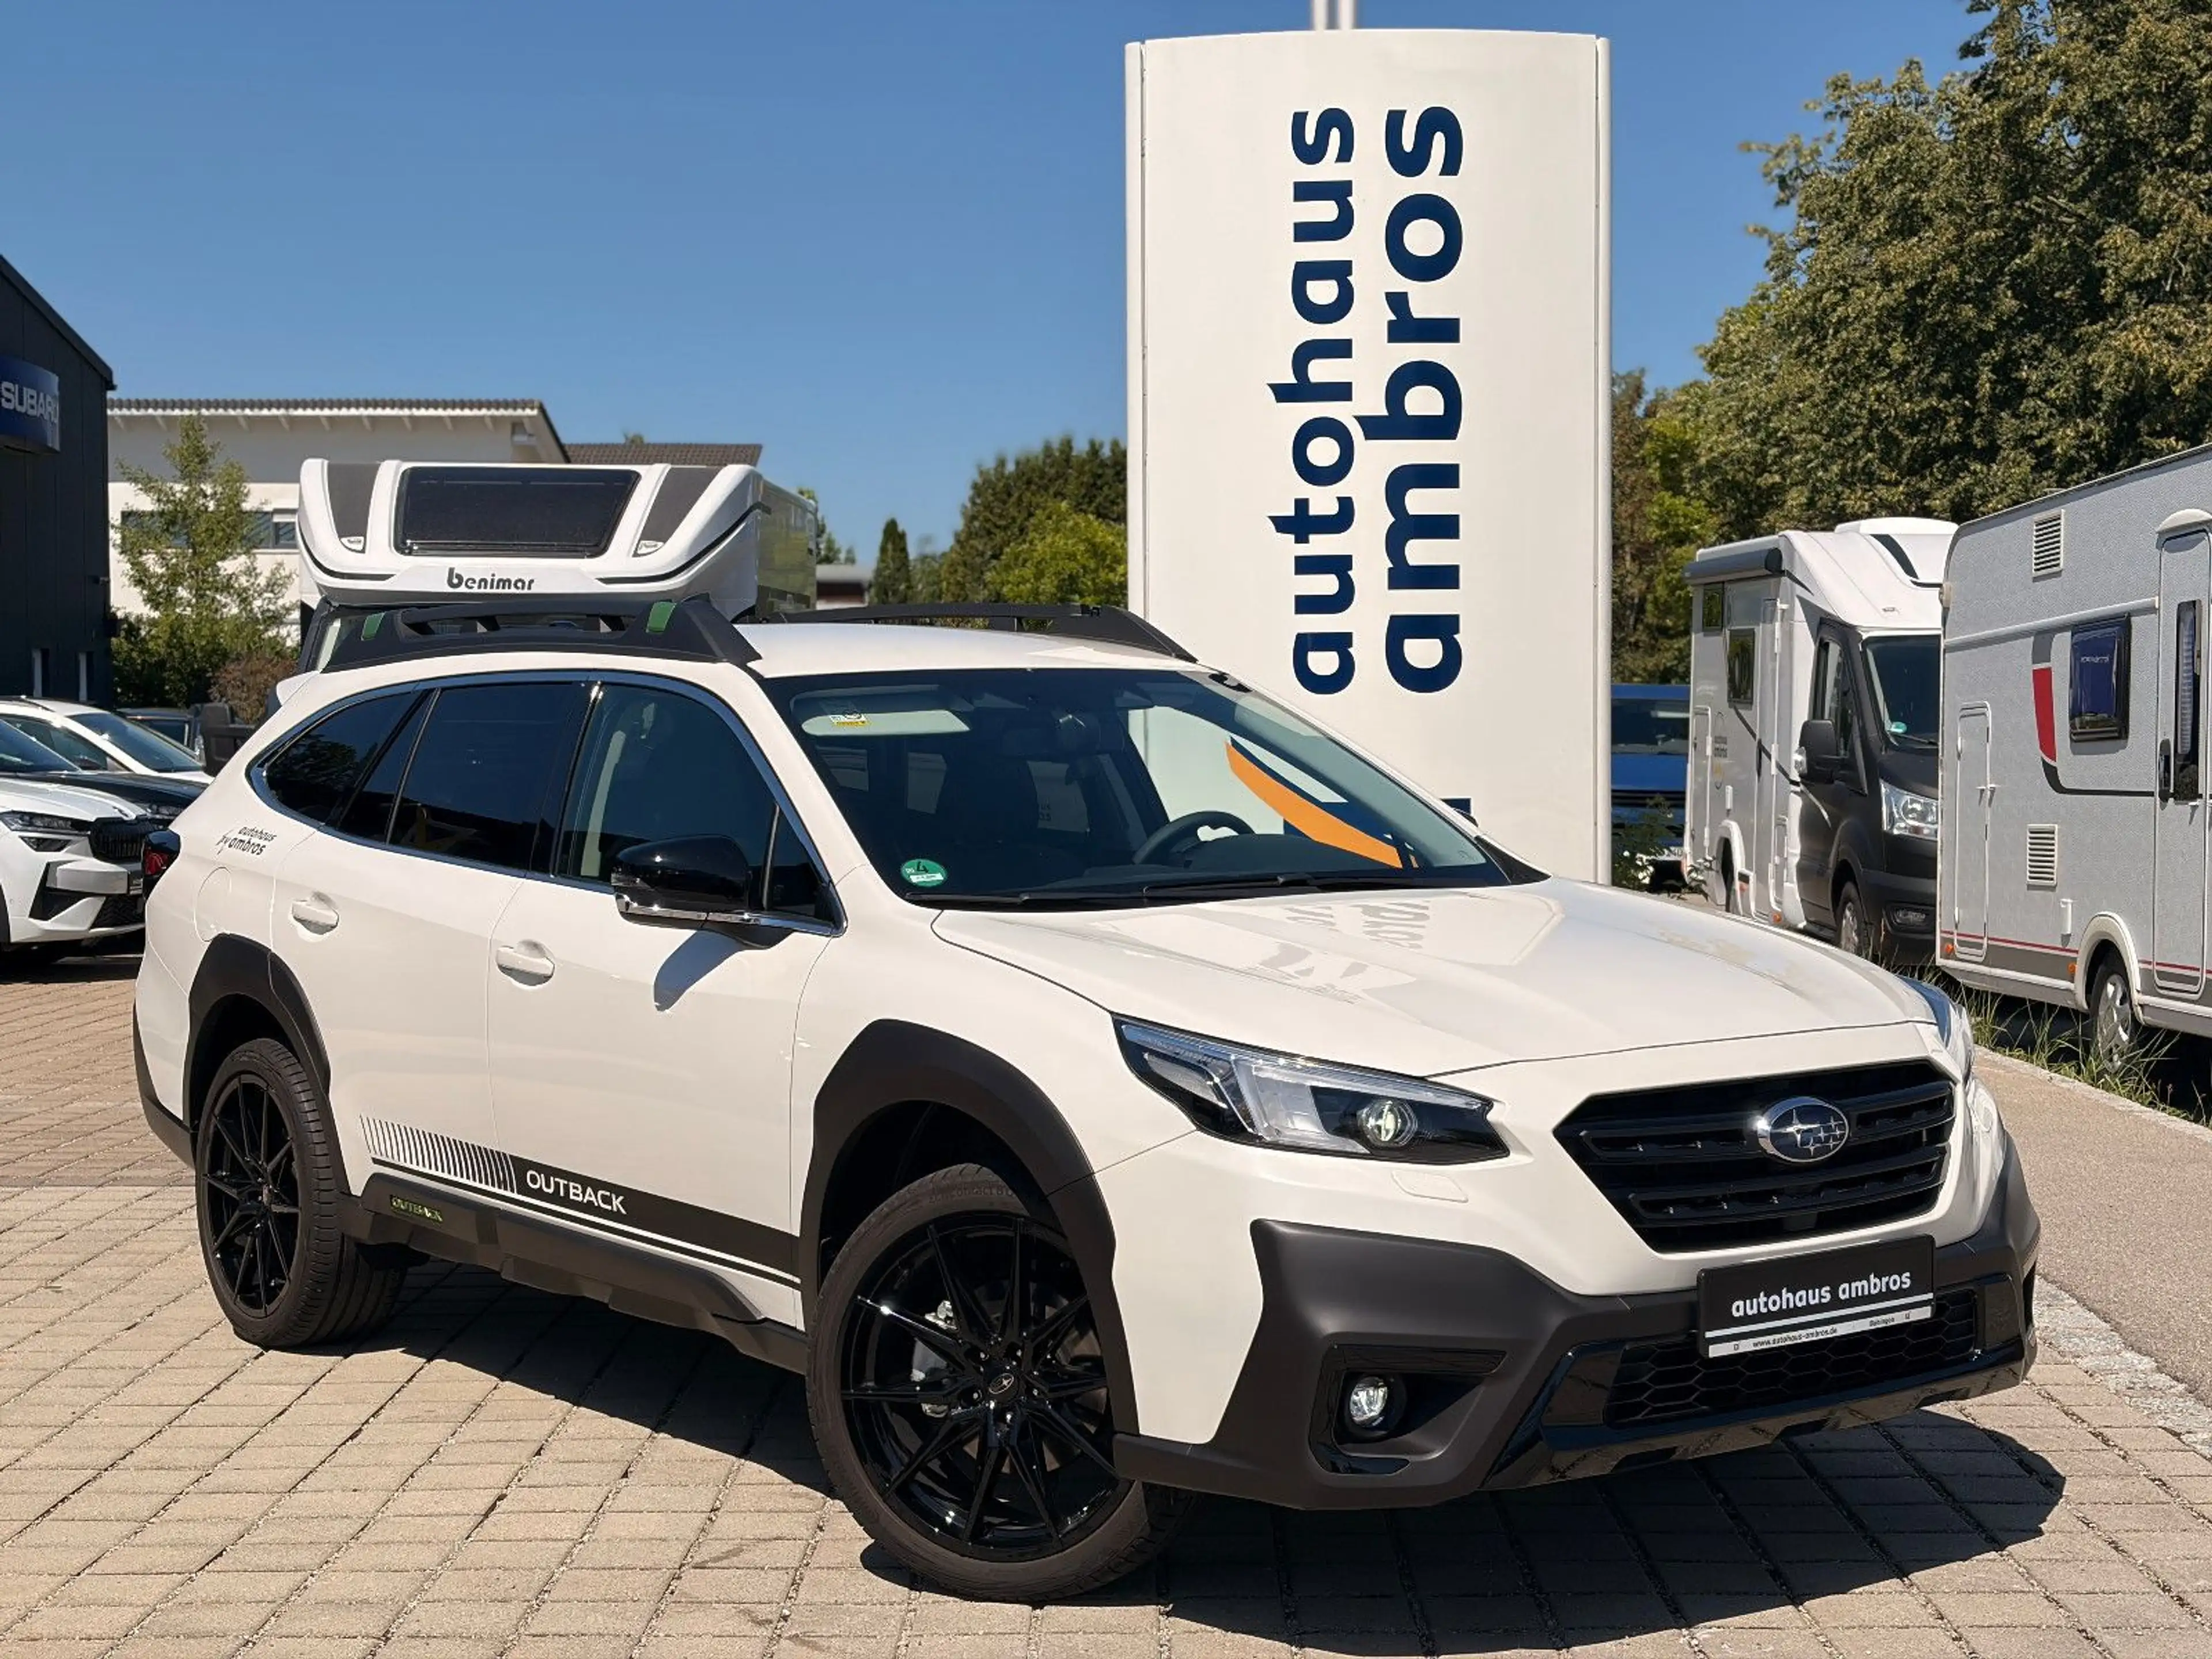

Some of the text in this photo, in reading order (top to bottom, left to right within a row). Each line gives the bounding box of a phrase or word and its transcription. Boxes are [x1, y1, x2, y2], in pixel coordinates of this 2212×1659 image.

[1266, 107, 1355, 695] autohaus
[1353, 106, 1464, 694] ambros
[446, 567, 535, 590] benimar
[228, 837, 266, 855] ambros
[527, 1170, 627, 1215] OUTBACK
[1732, 1272, 1911, 1317] autohaus ambros
